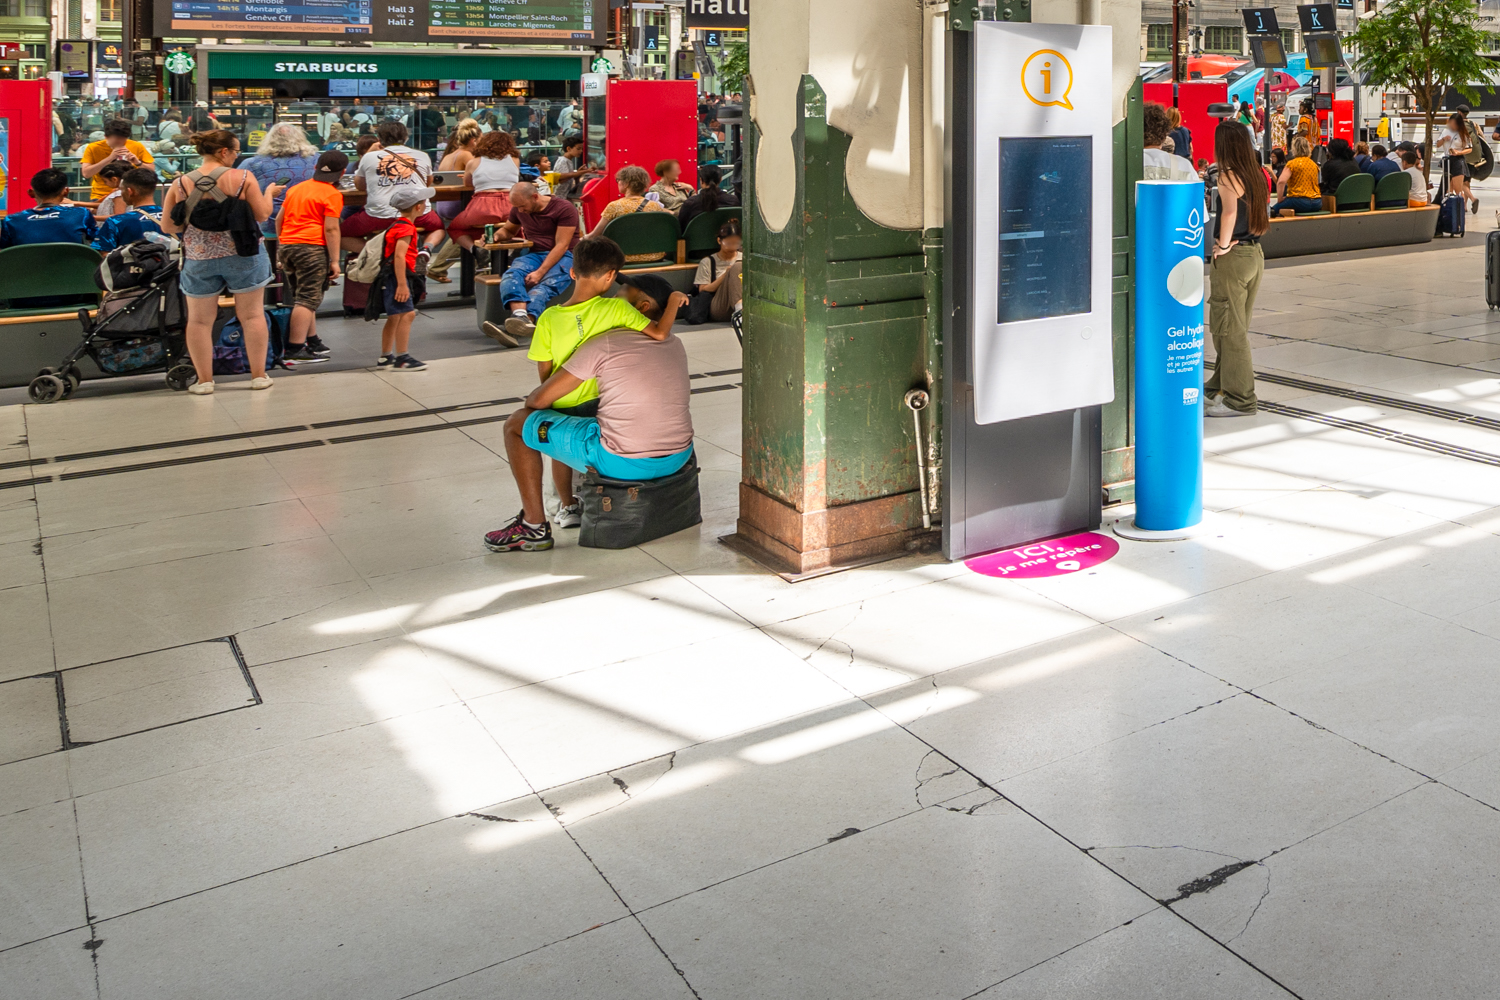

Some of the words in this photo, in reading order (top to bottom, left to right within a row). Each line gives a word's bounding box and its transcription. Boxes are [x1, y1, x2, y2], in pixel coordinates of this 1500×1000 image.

[245, 5, 288, 14] Montargis
[1258, 16, 1263, 29] J
[1311, 13, 1321, 26] K
[709, 36, 716, 44] C
[275, 62, 378, 73] STARBUCKS
[1167, 326, 1185, 337] Gel
[1019, 557, 1048, 569] me
[1050, 542, 1102, 561] repère
